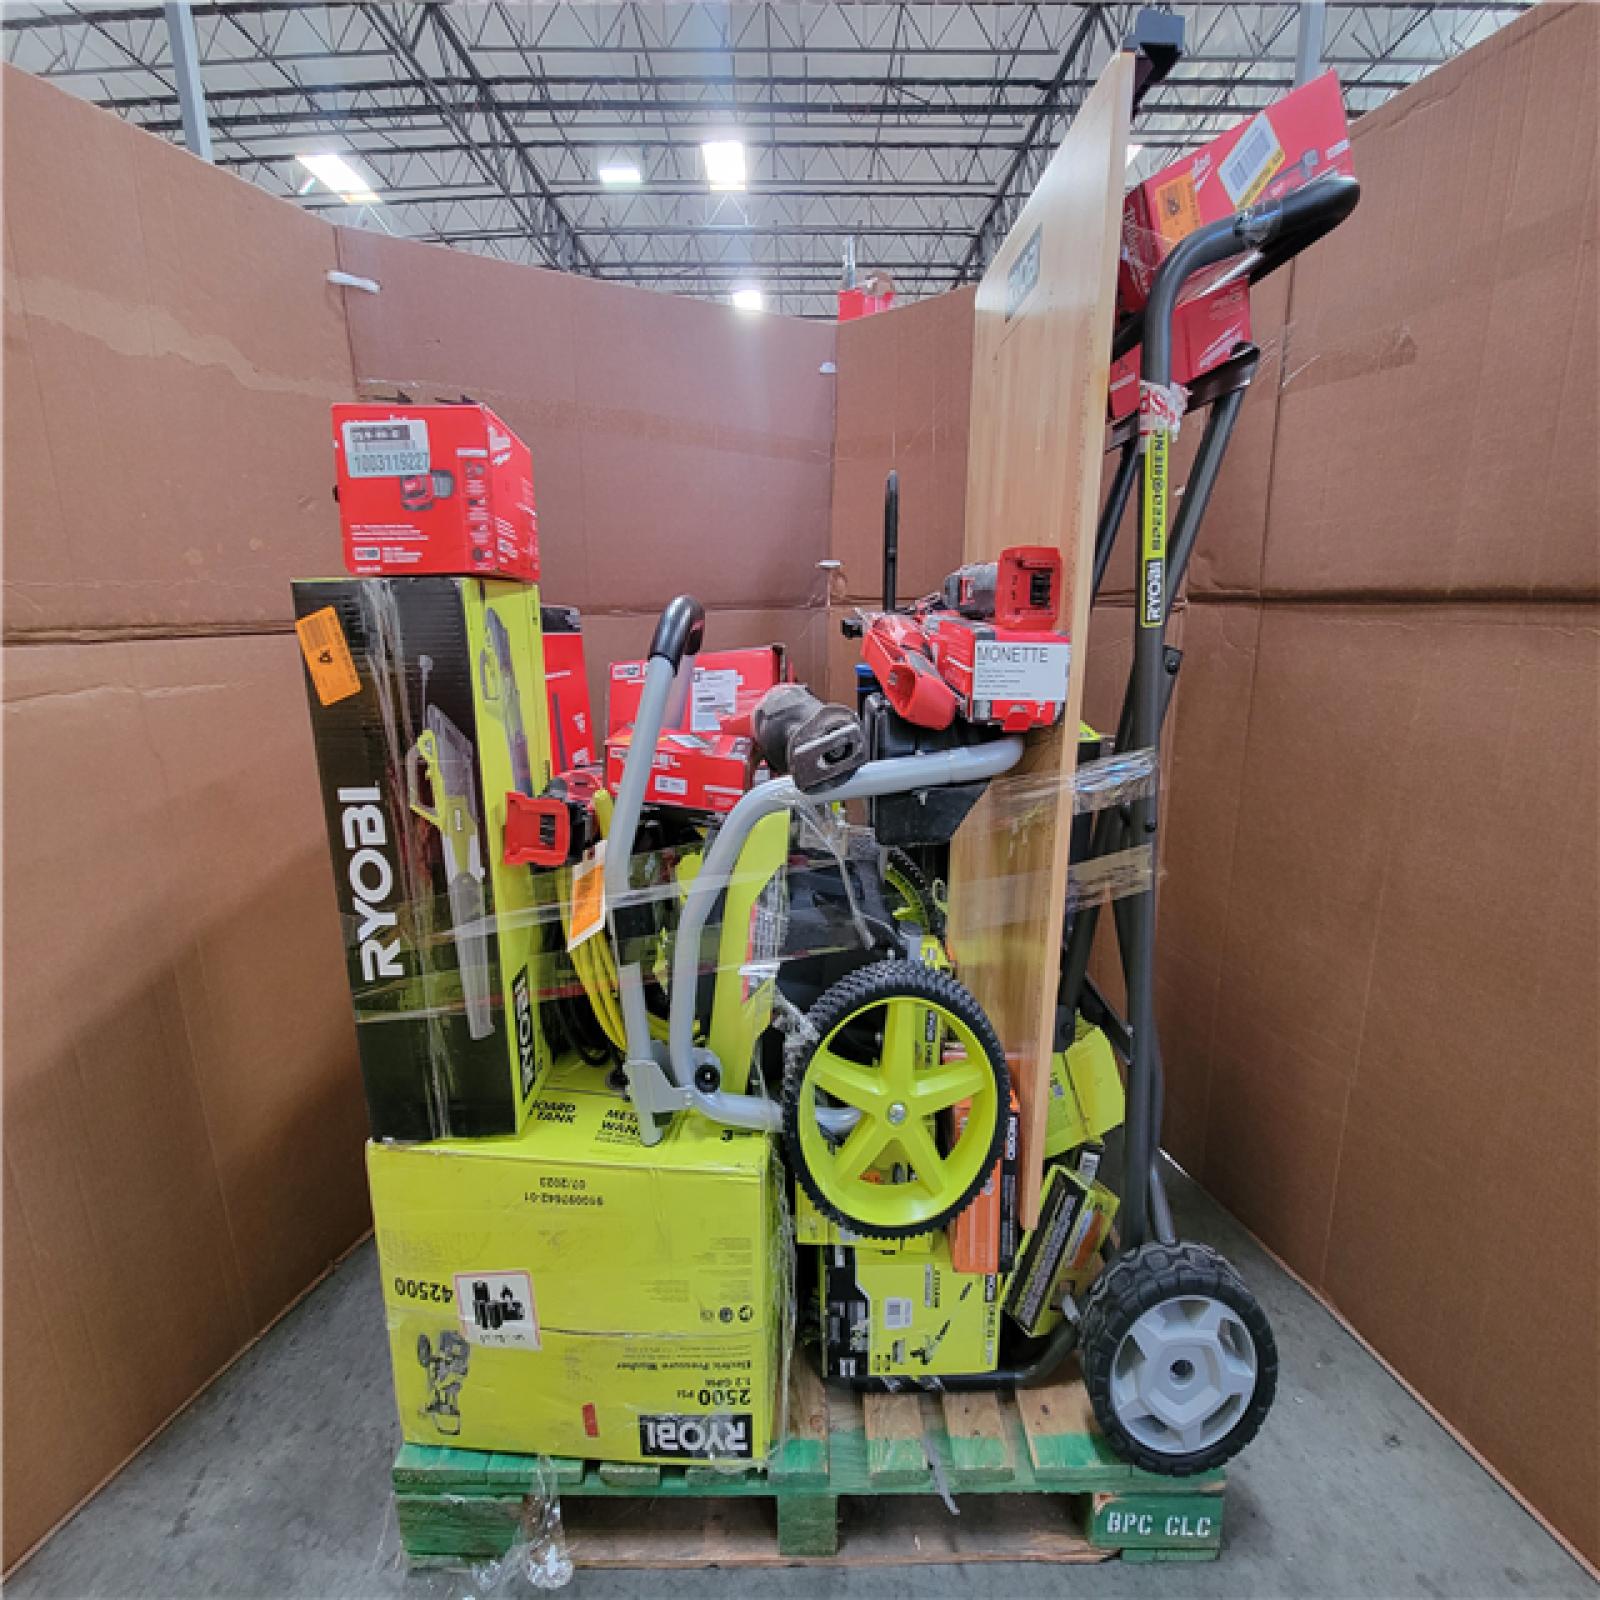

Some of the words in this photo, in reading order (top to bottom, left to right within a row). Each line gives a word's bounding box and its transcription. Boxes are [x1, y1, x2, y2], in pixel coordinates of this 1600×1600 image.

[1146, 562, 1161, 620] RYOBI
[976, 645, 1049, 663] MONETTE
[337, 787, 405, 981] RYOBI
[394, 1277, 454, 1304] 42500
[698, 1389, 751, 1405] 2500
[647, 1422, 749, 1451] RYOBI
[1164, 1514, 1211, 1538] CLC
